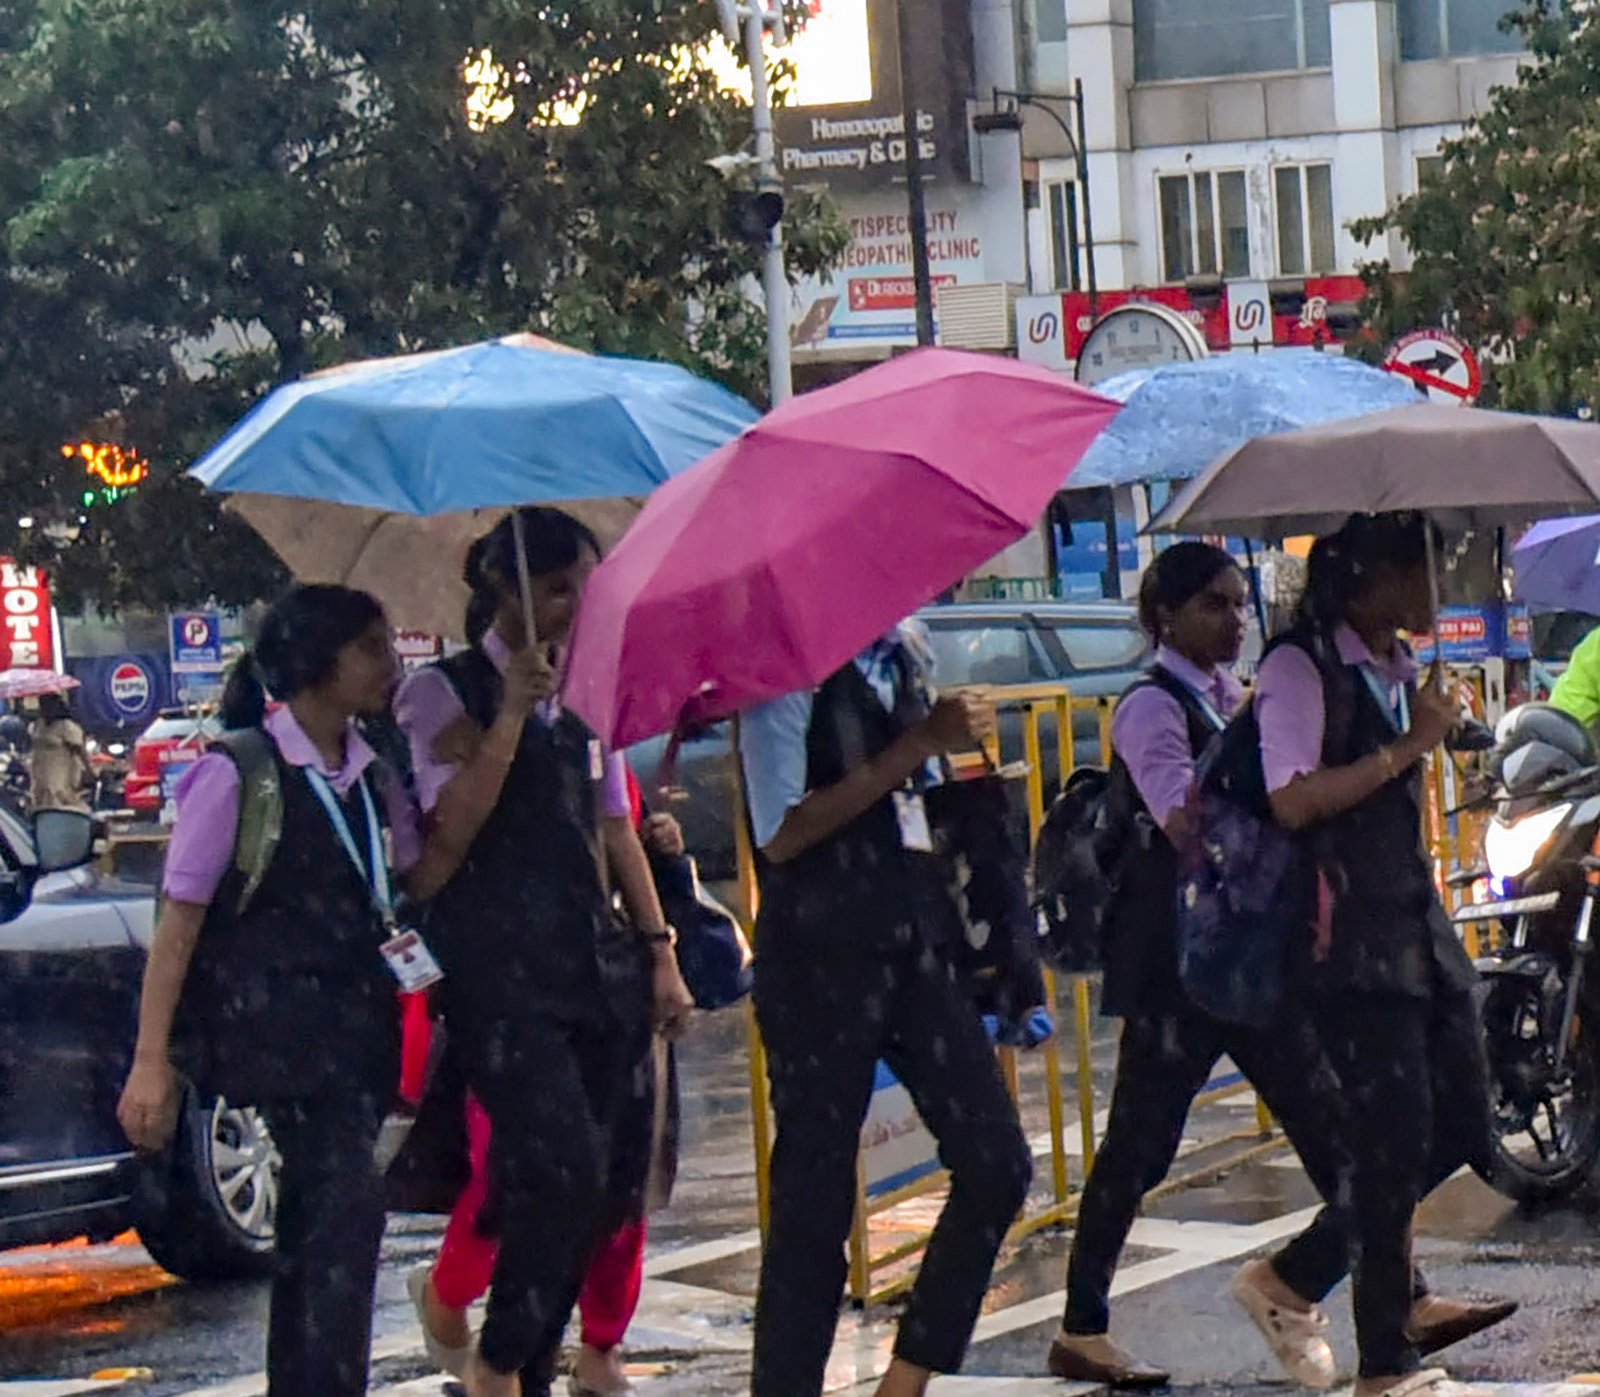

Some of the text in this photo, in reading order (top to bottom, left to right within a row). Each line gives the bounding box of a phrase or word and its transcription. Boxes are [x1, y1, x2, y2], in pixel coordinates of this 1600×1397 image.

[783, 137, 937, 171] Pharmacy & Clic
[926, 237, 981, 260] CLINIC
[1, 563, 40, 666] HOTE
